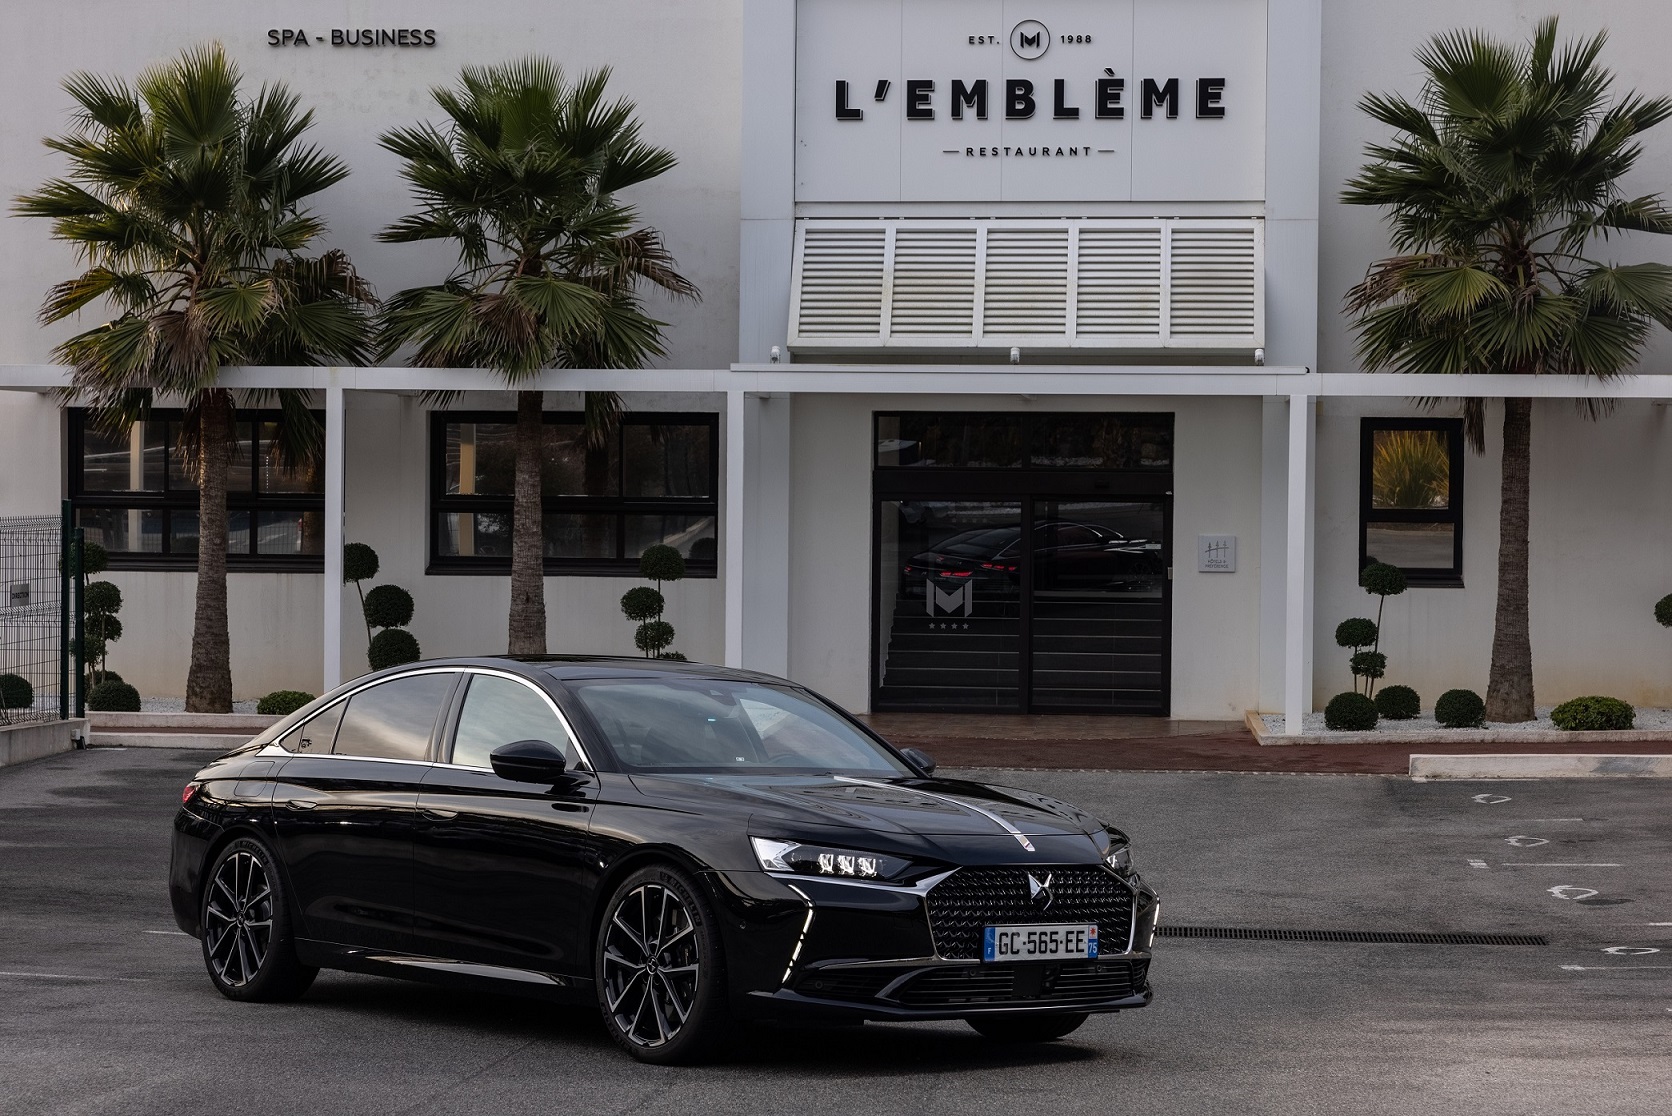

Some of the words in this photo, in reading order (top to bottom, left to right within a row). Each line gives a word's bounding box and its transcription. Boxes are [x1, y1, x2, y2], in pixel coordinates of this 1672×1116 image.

[267, 28, 310, 46] SPA
[331, 28, 437, 46] BUSINESS
[968, 35, 1001, 45] EST.
[1060, 34, 1093, 44] 1988
[835, 67, 1226, 120] L'EMBLÈME
[966, 146, 1092, 157] RESTAURANT
[669, 876, 702, 925] MICHELIN
[998, 930, 1085, 955] GC-565-EE
[1088, 942, 1098, 954] 75
[987, 947, 992, 955] F
